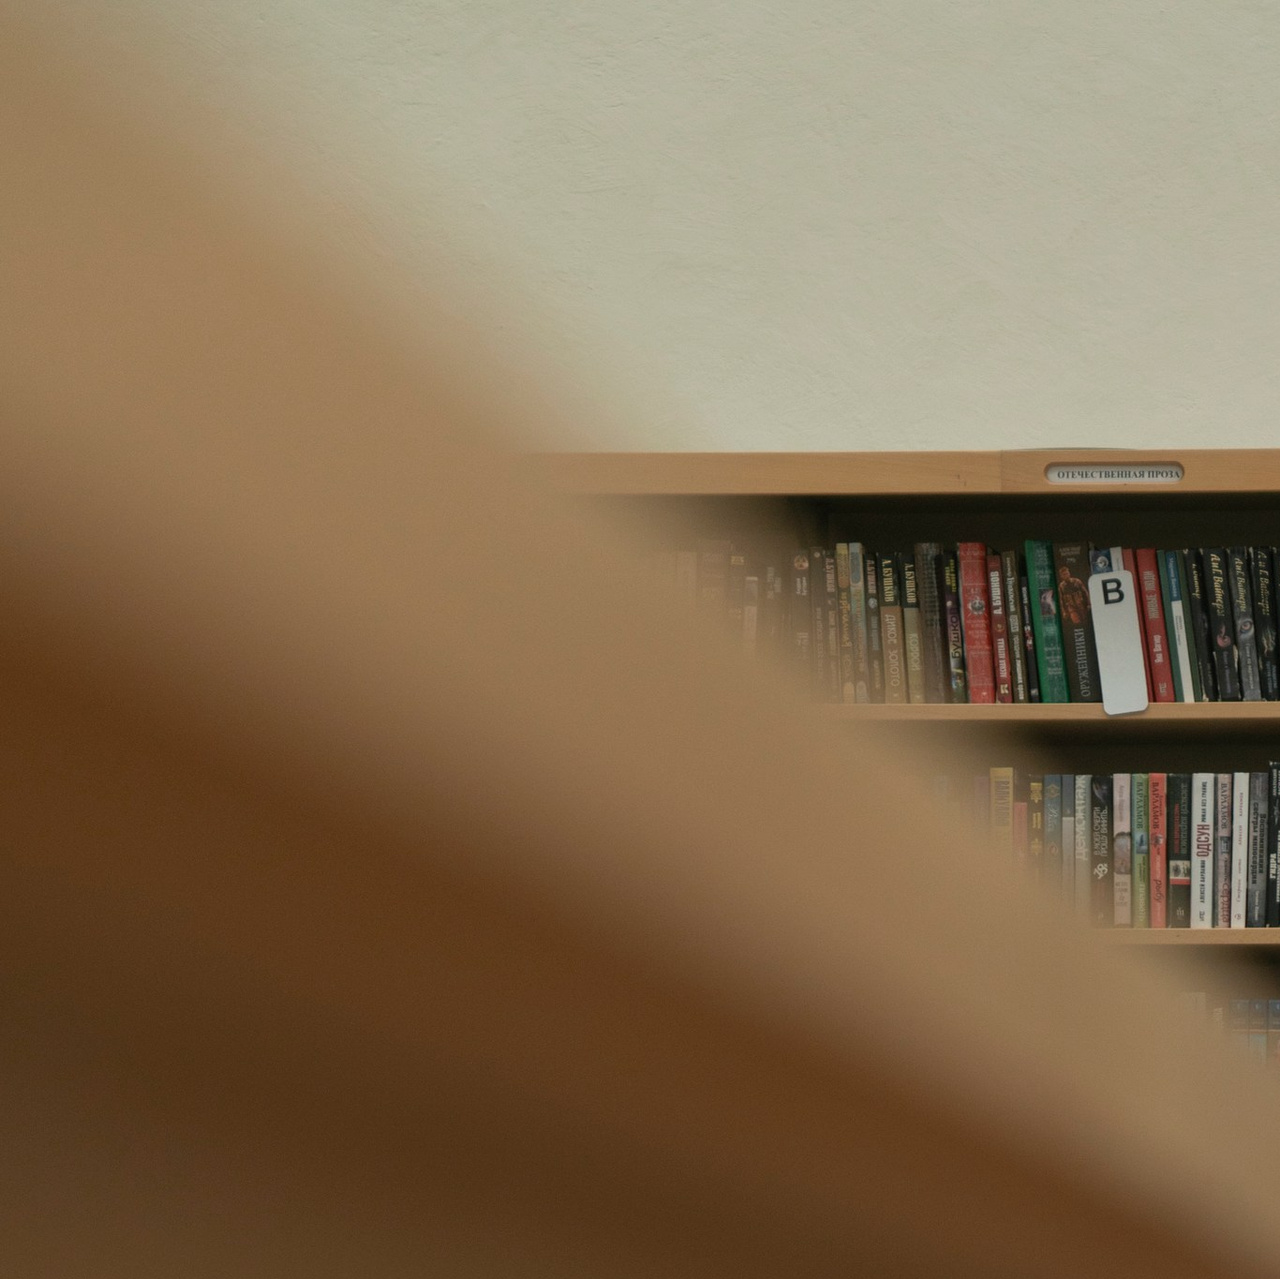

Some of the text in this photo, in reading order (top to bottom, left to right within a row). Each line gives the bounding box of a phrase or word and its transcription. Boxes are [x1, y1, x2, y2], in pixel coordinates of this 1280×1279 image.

[1057, 470, 1180, 479] ОТЕЧЕСТВЕННАЯ ПРОЗА
[1102, 578, 1123, 604] В
[1074, 628, 1091, 696] ОРУЖЕЙНИКИ
[1196, 824, 1210, 857] ОДСУН
